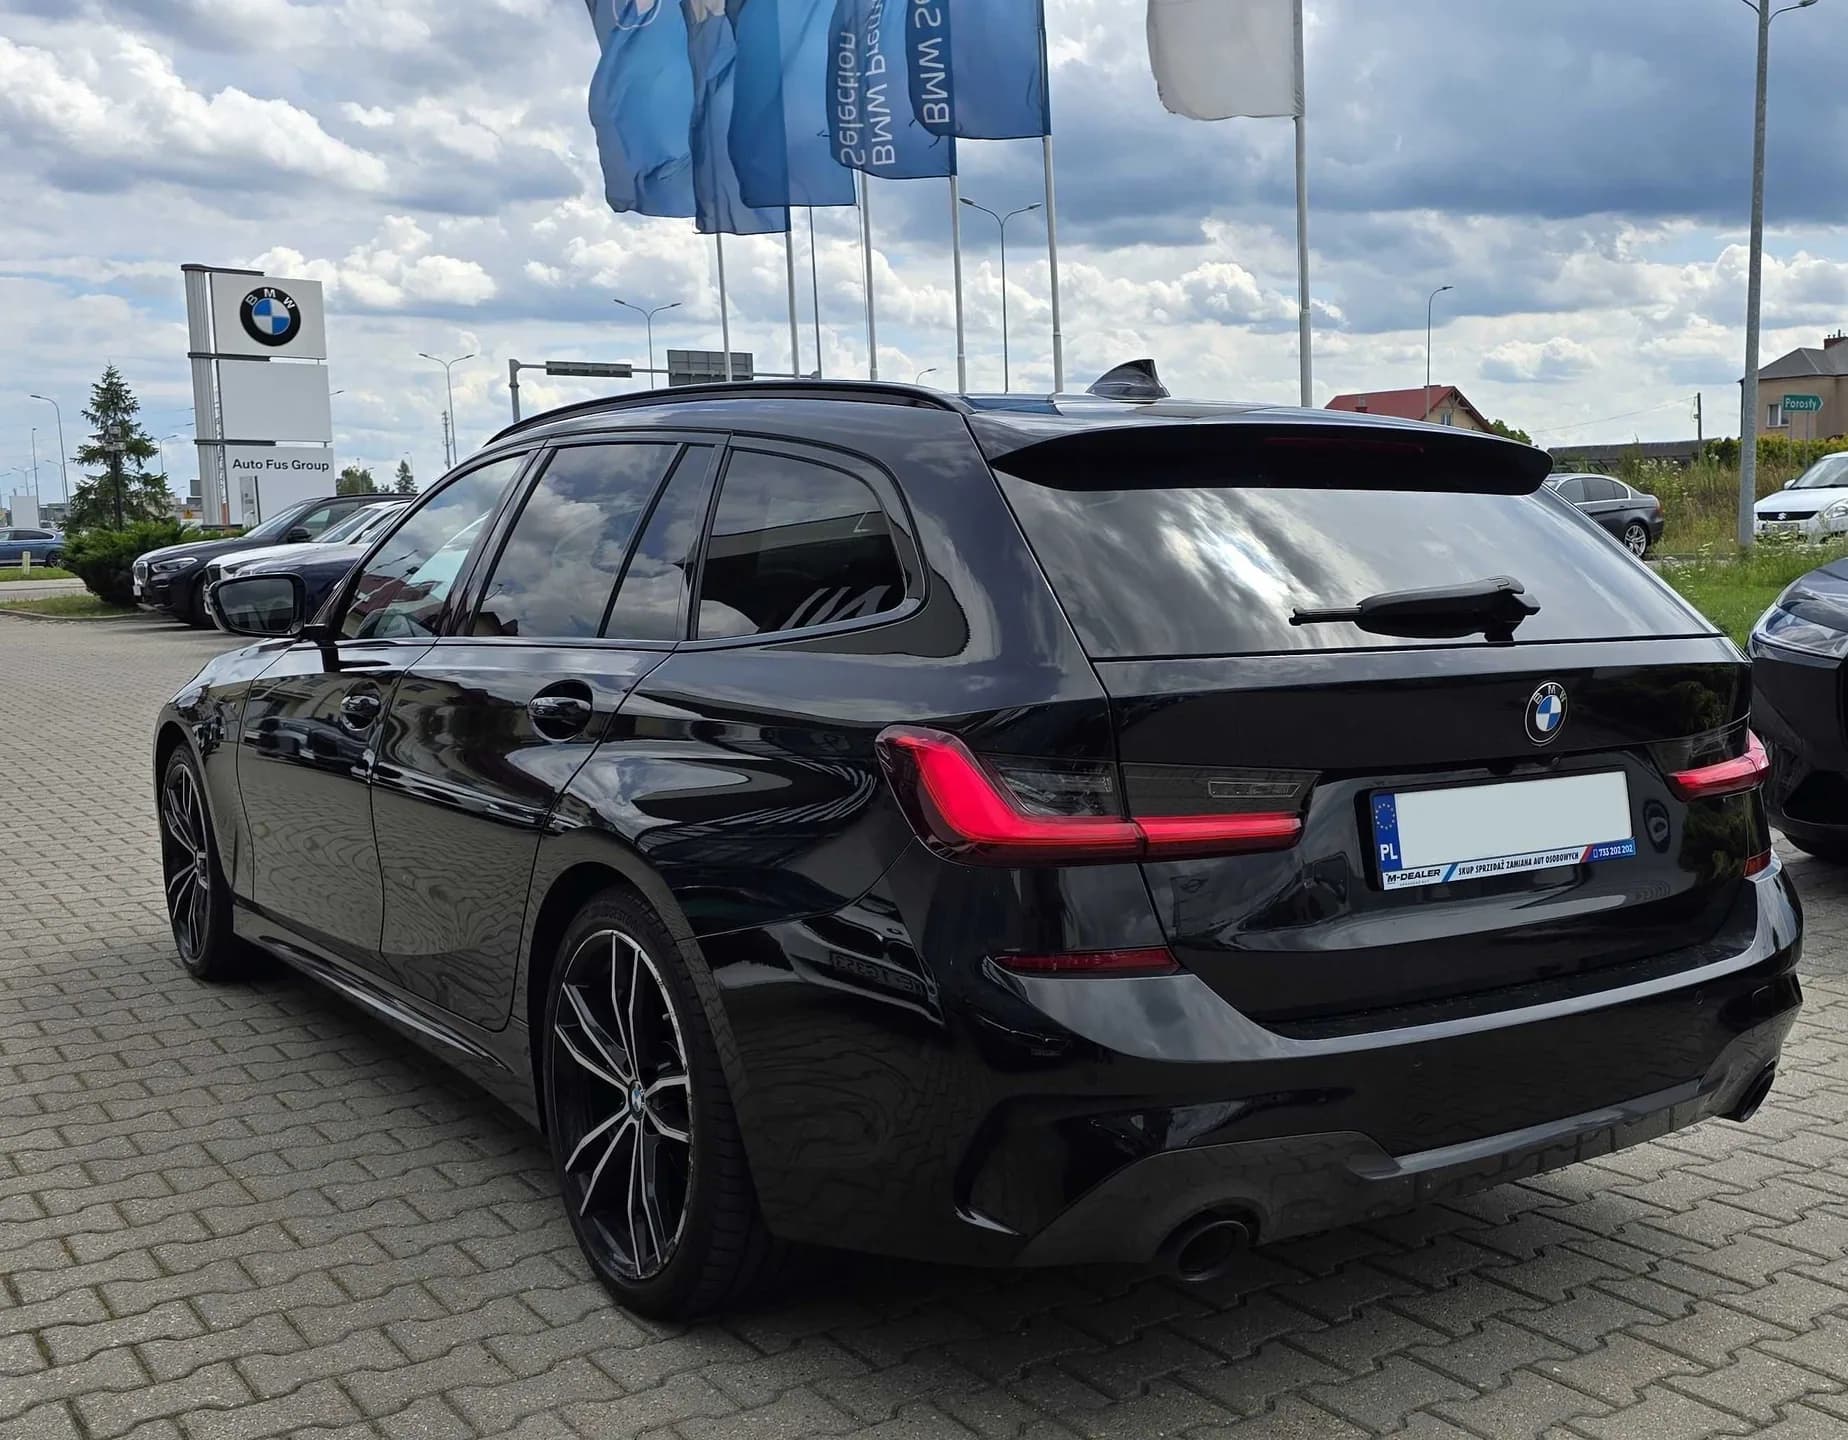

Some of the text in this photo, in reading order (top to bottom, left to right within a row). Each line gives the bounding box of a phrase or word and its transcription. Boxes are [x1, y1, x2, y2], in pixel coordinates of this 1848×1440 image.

[232, 458, 330, 473] Auto Fus Group
[1380, 842, 1399, 862] PL
[1598, 843, 1634, 857] 733 202 202
[1458, 865, 1475, 876] SKUP
[1506, 858, 1533, 869] ZAMIANA
[1533, 856, 1546, 865] AUT
[1546, 851, 1580, 864] OSOBOWYCH
[1386, 868, 1441, 884] M-DEALER
